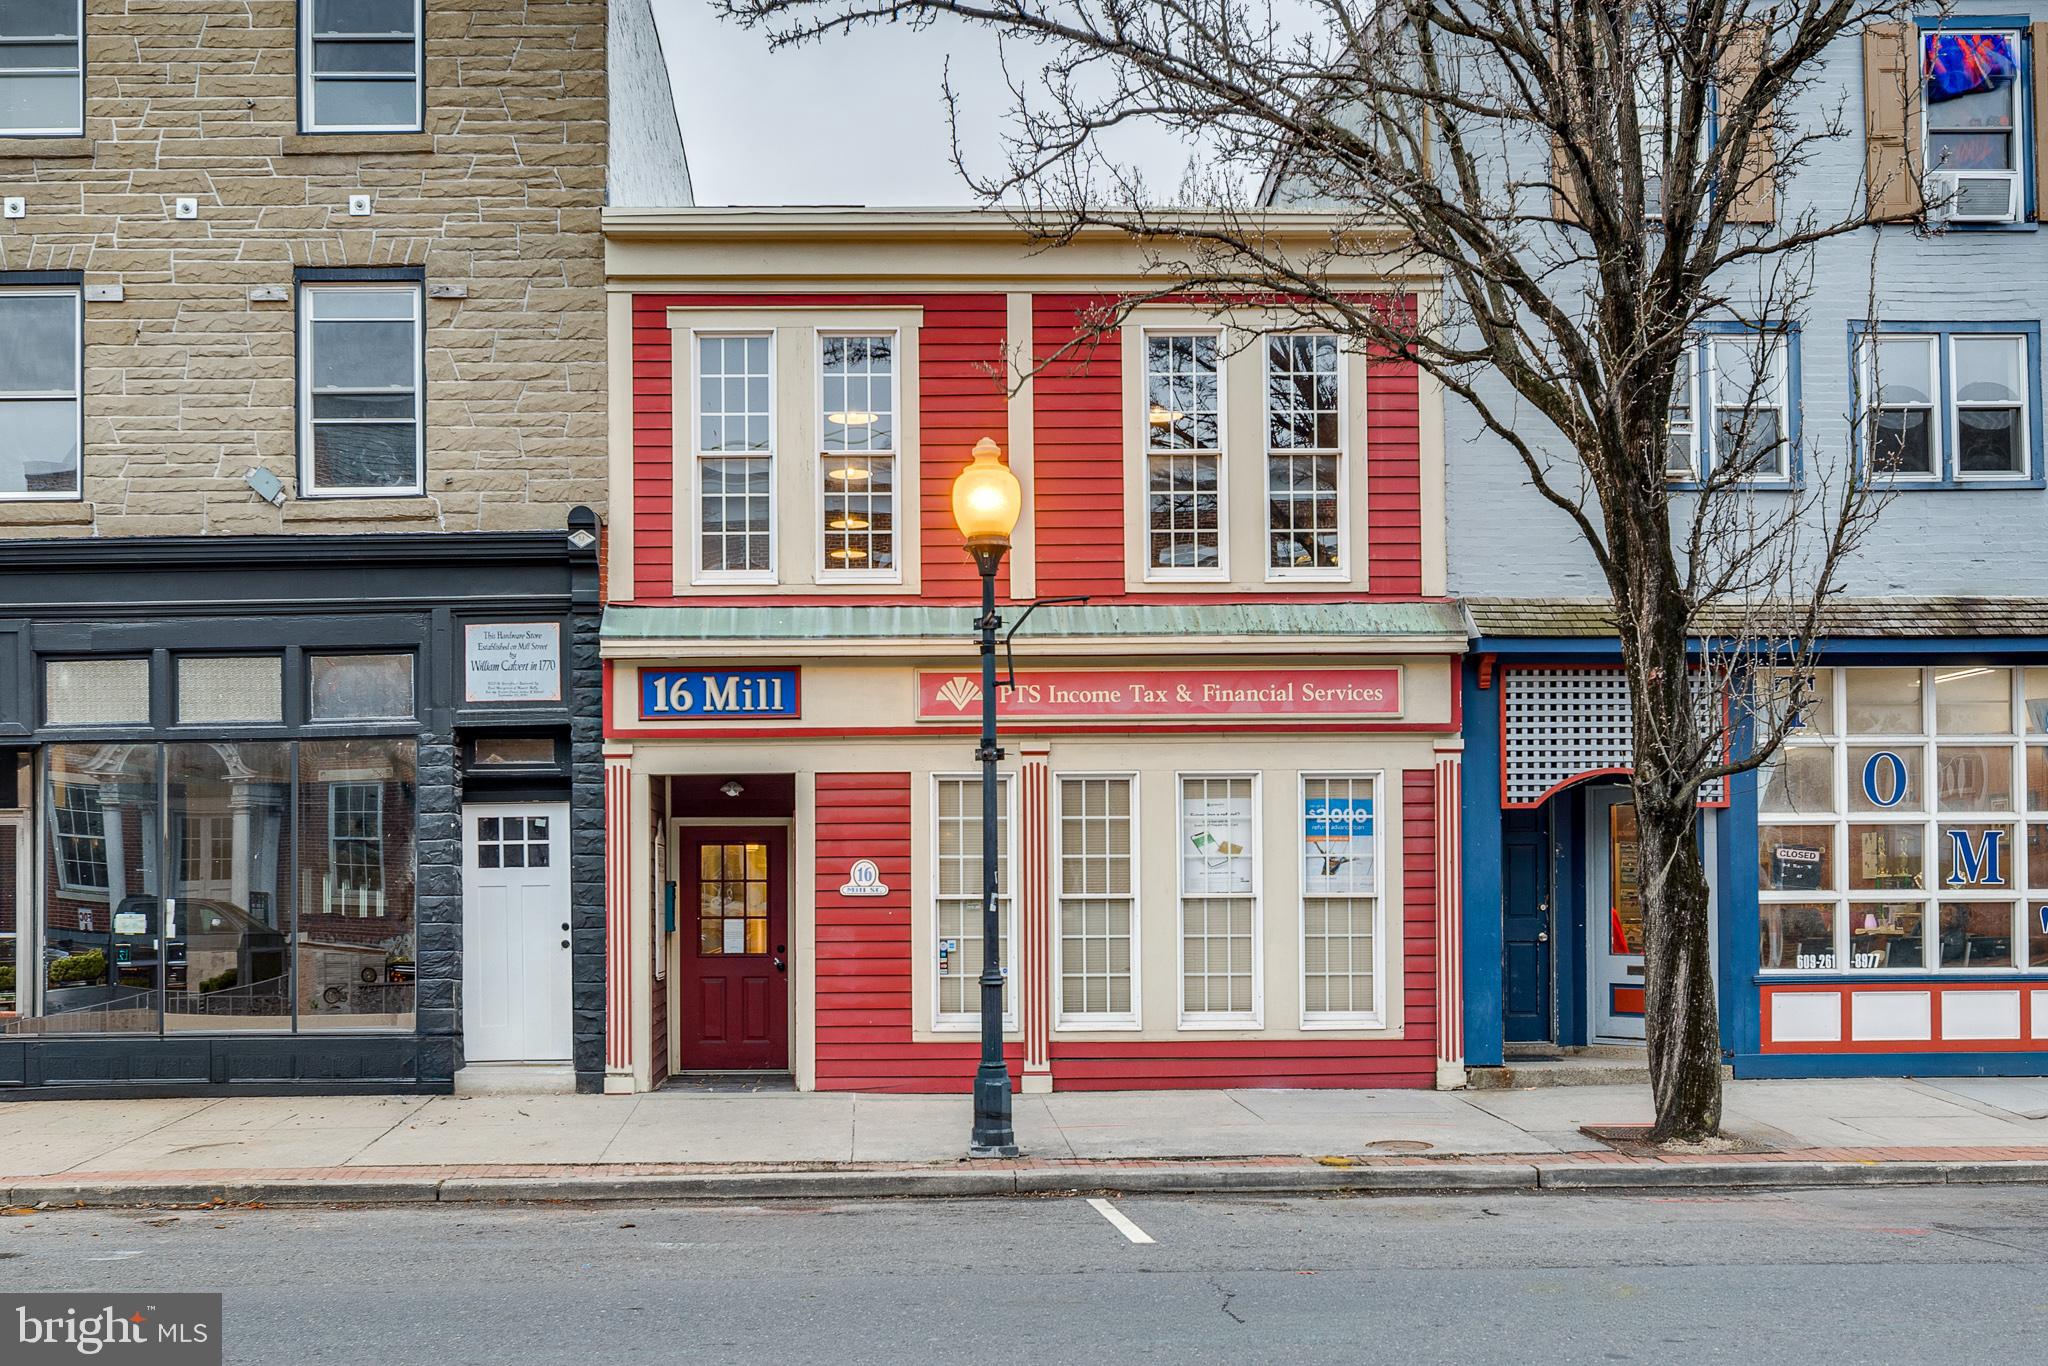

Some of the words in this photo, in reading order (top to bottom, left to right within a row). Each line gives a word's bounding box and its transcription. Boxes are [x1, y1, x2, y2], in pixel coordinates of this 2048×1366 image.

[526, 630, 542, 639] Store
[471, 660, 500, 671] William
[530, 661, 537, 671] in
[540, 660, 556, 671] 1770
[653, 676, 694, 712] 16
[703, 676, 784, 711] Mill
[999, 684, 1041, 704] PTS
[1048, 684, 1121, 703] Income
[1129, 684, 1168, 703] Tax
[1176, 684, 1193, 703] &
[1202, 682, 1294, 703] Financial
[1302, 683, 1383, 702] Services
[1780, 849, 1816, 860] CLOSED
[857, 867, 872, 881] 16
